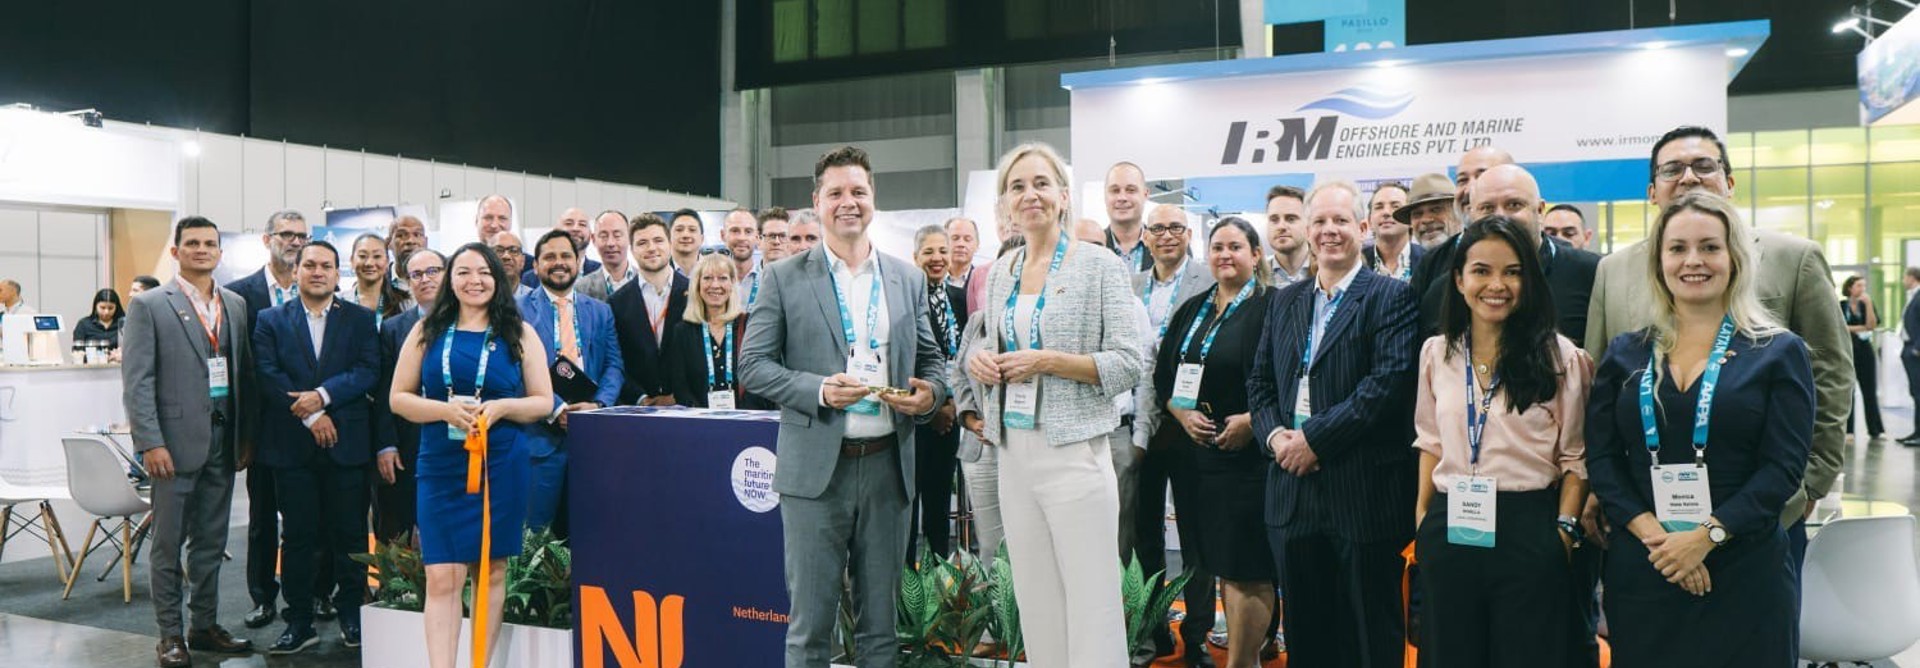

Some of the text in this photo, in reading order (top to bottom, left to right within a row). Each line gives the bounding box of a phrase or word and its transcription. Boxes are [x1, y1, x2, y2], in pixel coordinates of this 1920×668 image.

[1221, 116, 1339, 165] IRM
[1340, 117, 1524, 142] OFFSHORE AND MARINE
[1336, 140, 1421, 159] ENGINEERS
[1426, 138, 1458, 154] PVT.
[1711, 321, 1734, 354] LATAM
[1696, 381, 1714, 428] AAPA
[745, 457, 760, 469] The
[745, 478, 770, 490] future
